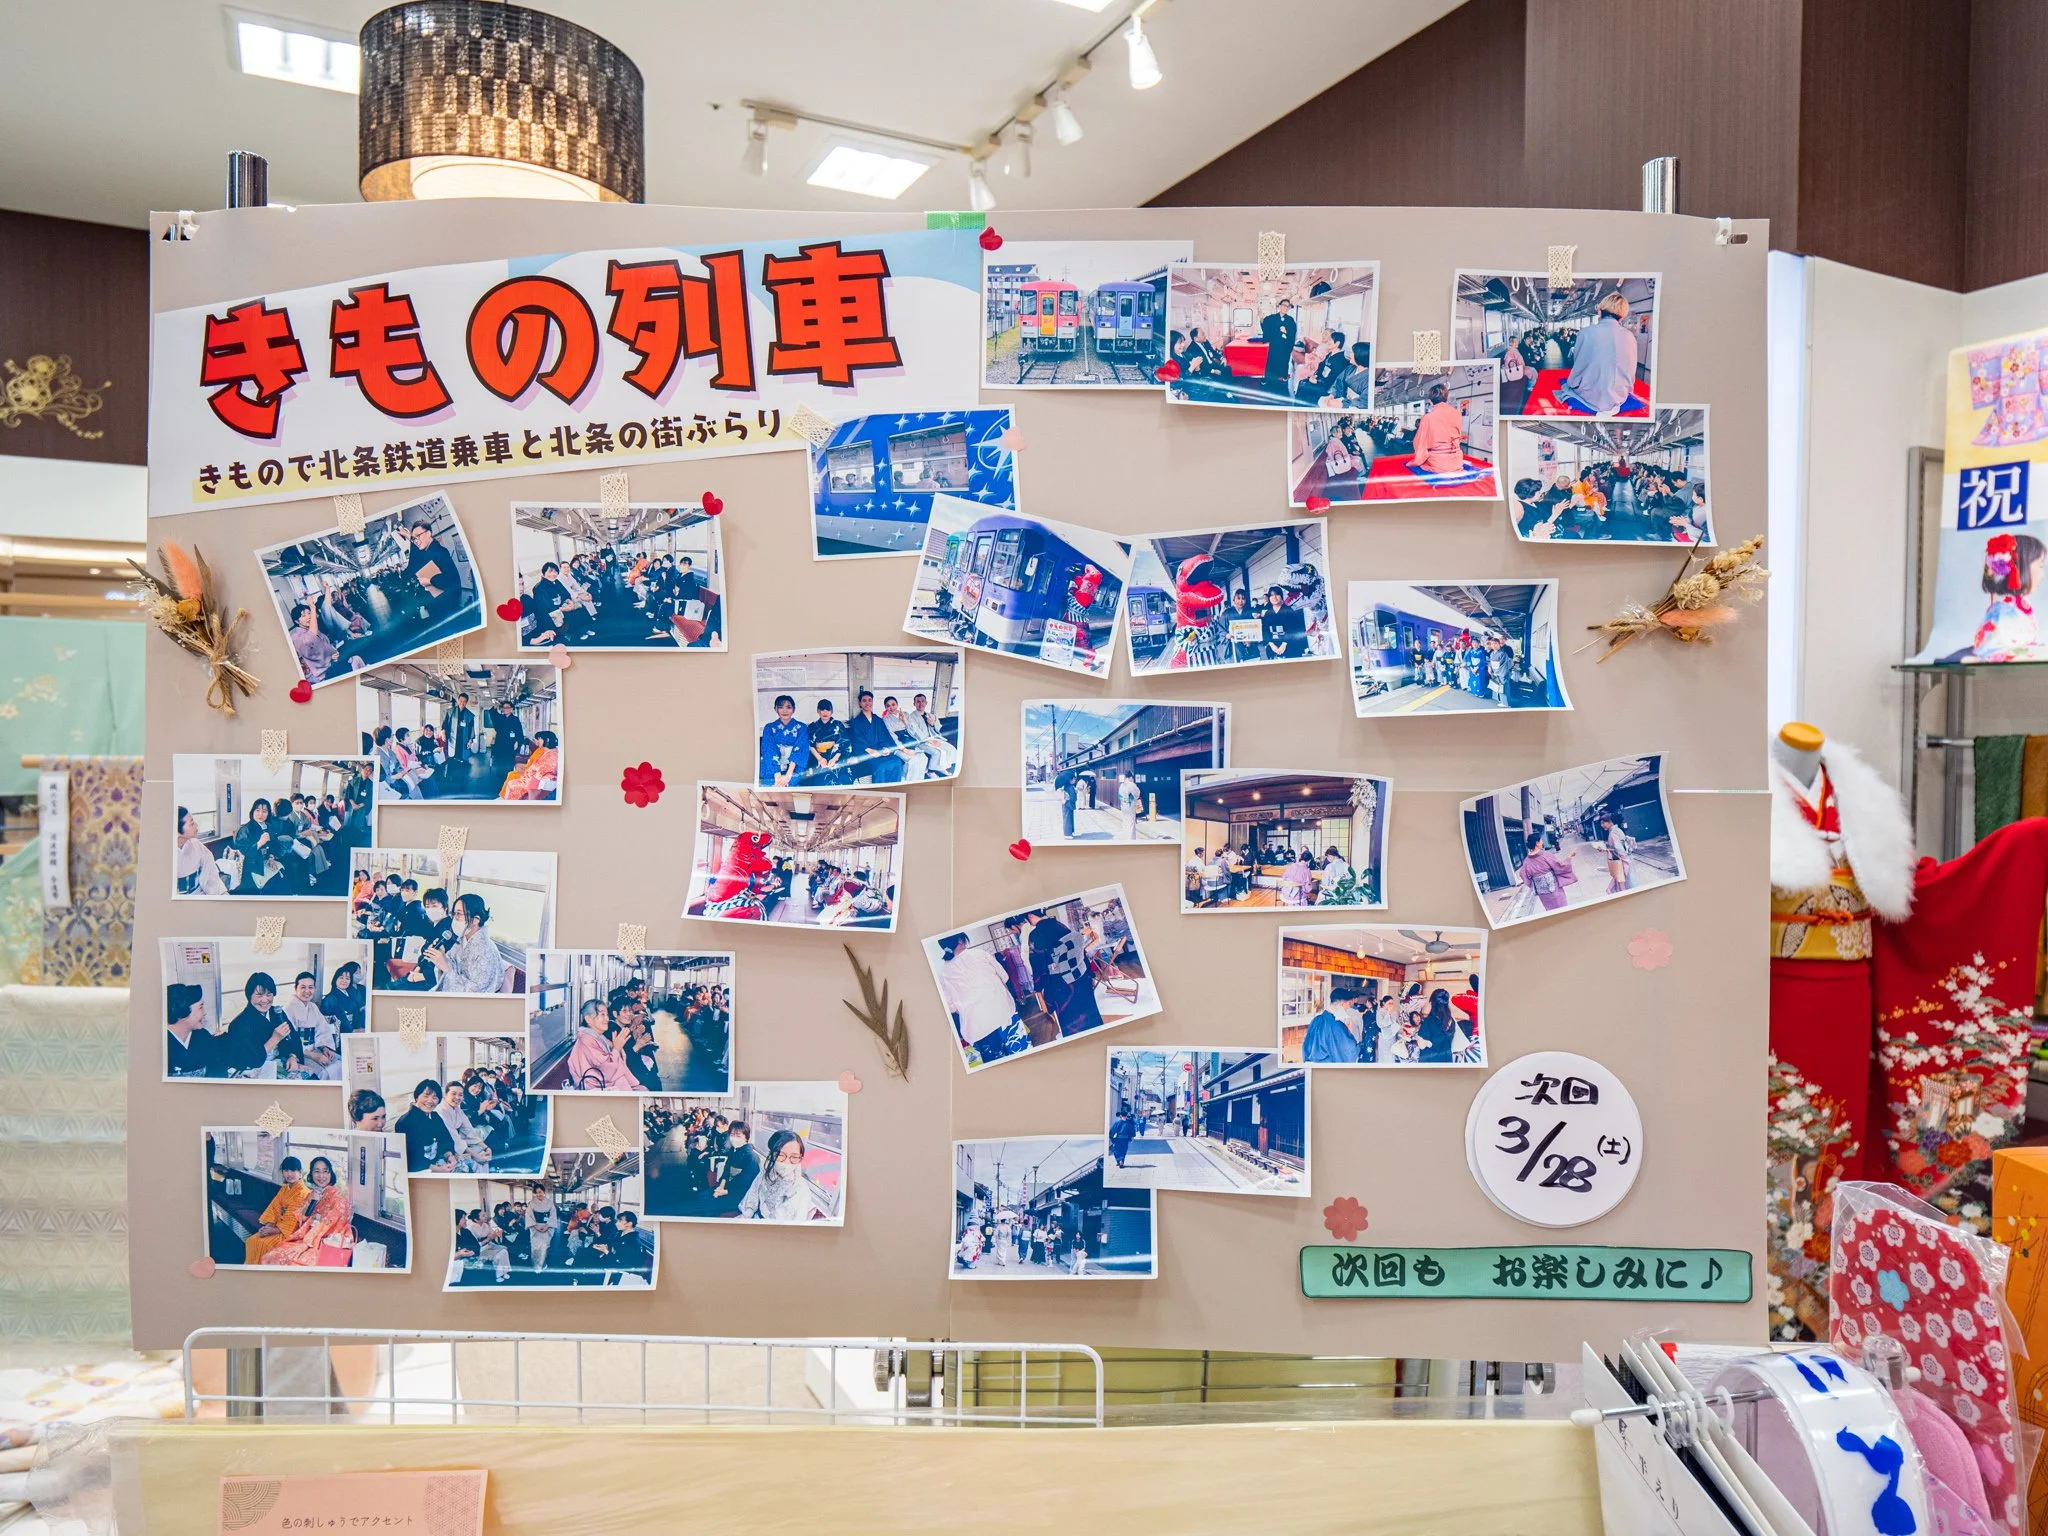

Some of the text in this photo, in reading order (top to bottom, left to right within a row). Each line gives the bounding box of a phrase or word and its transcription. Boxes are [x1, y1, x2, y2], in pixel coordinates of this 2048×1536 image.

[200, 241, 904, 439] きもの列車
[199, 409, 783, 494] きもので北条鉄道乗車と北条の街ぶらり
[1960, 466, 2023, 528] 祝
[1515, 1073, 1599, 1105] 次回
[1331, 1252, 1445, 1289] 次回も
[282, 1515, 413, 1529] 色の刺しゅうでアクセント
